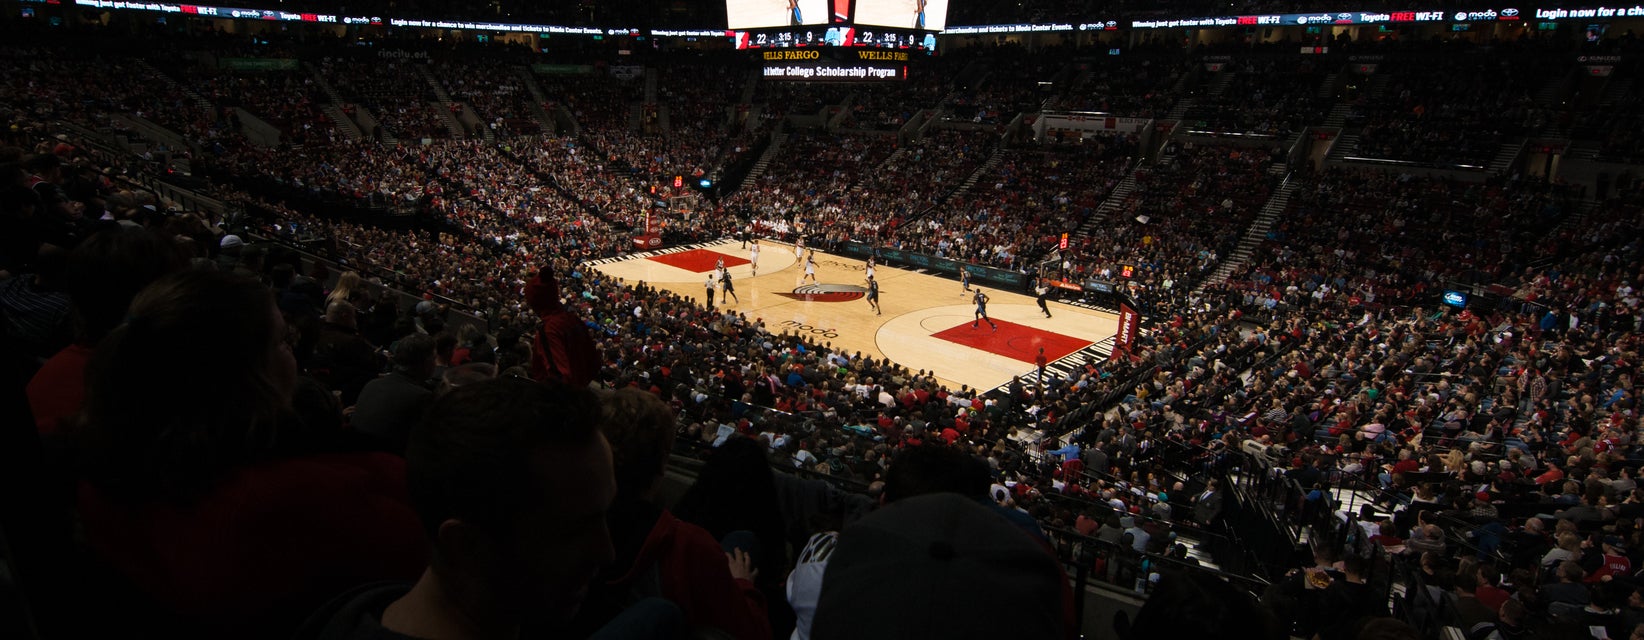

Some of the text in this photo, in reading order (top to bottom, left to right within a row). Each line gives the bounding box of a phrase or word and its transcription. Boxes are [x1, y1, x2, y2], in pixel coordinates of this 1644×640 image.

[160, 4, 180, 13] Toyota
[180, 5, 197, 14] FREE
[1468, 9, 1497, 17] moda
[1536, 8, 1567, 20] Login
[1569, 9, 1596, 18] now
[1597, 7, 1616, 17] for
[1617, 8, 1626, 16] a
[280, 12, 301, 21] Toyota
[301, 13, 317, 22] FREE
[1155, 20, 1168, 28] just
[1169, 20, 1179, 28] got
[1215, 18, 1236, 26] Toyota
[1237, 16, 1257, 25] FREE
[1258, 16, 1280, 24] WI-FI
[1360, 13, 1390, 22] Toyota
[1391, 12, 1414, 21] FREE
[1416, 11, 1443, 20] WI-FI
[391, 18, 408, 27] Login
[757, 31, 812, 44] 22 3:15 9
[863, 32, 914, 45] 22 3:15 9
[784, 50, 819, 59] FARGO
[858, 51, 893, 60] WELLS
[786, 66, 814, 78] College
[816, 66, 865, 78] Scholarship
[868, 67, 896, 79] Program
[781, 320, 839, 338] moda
